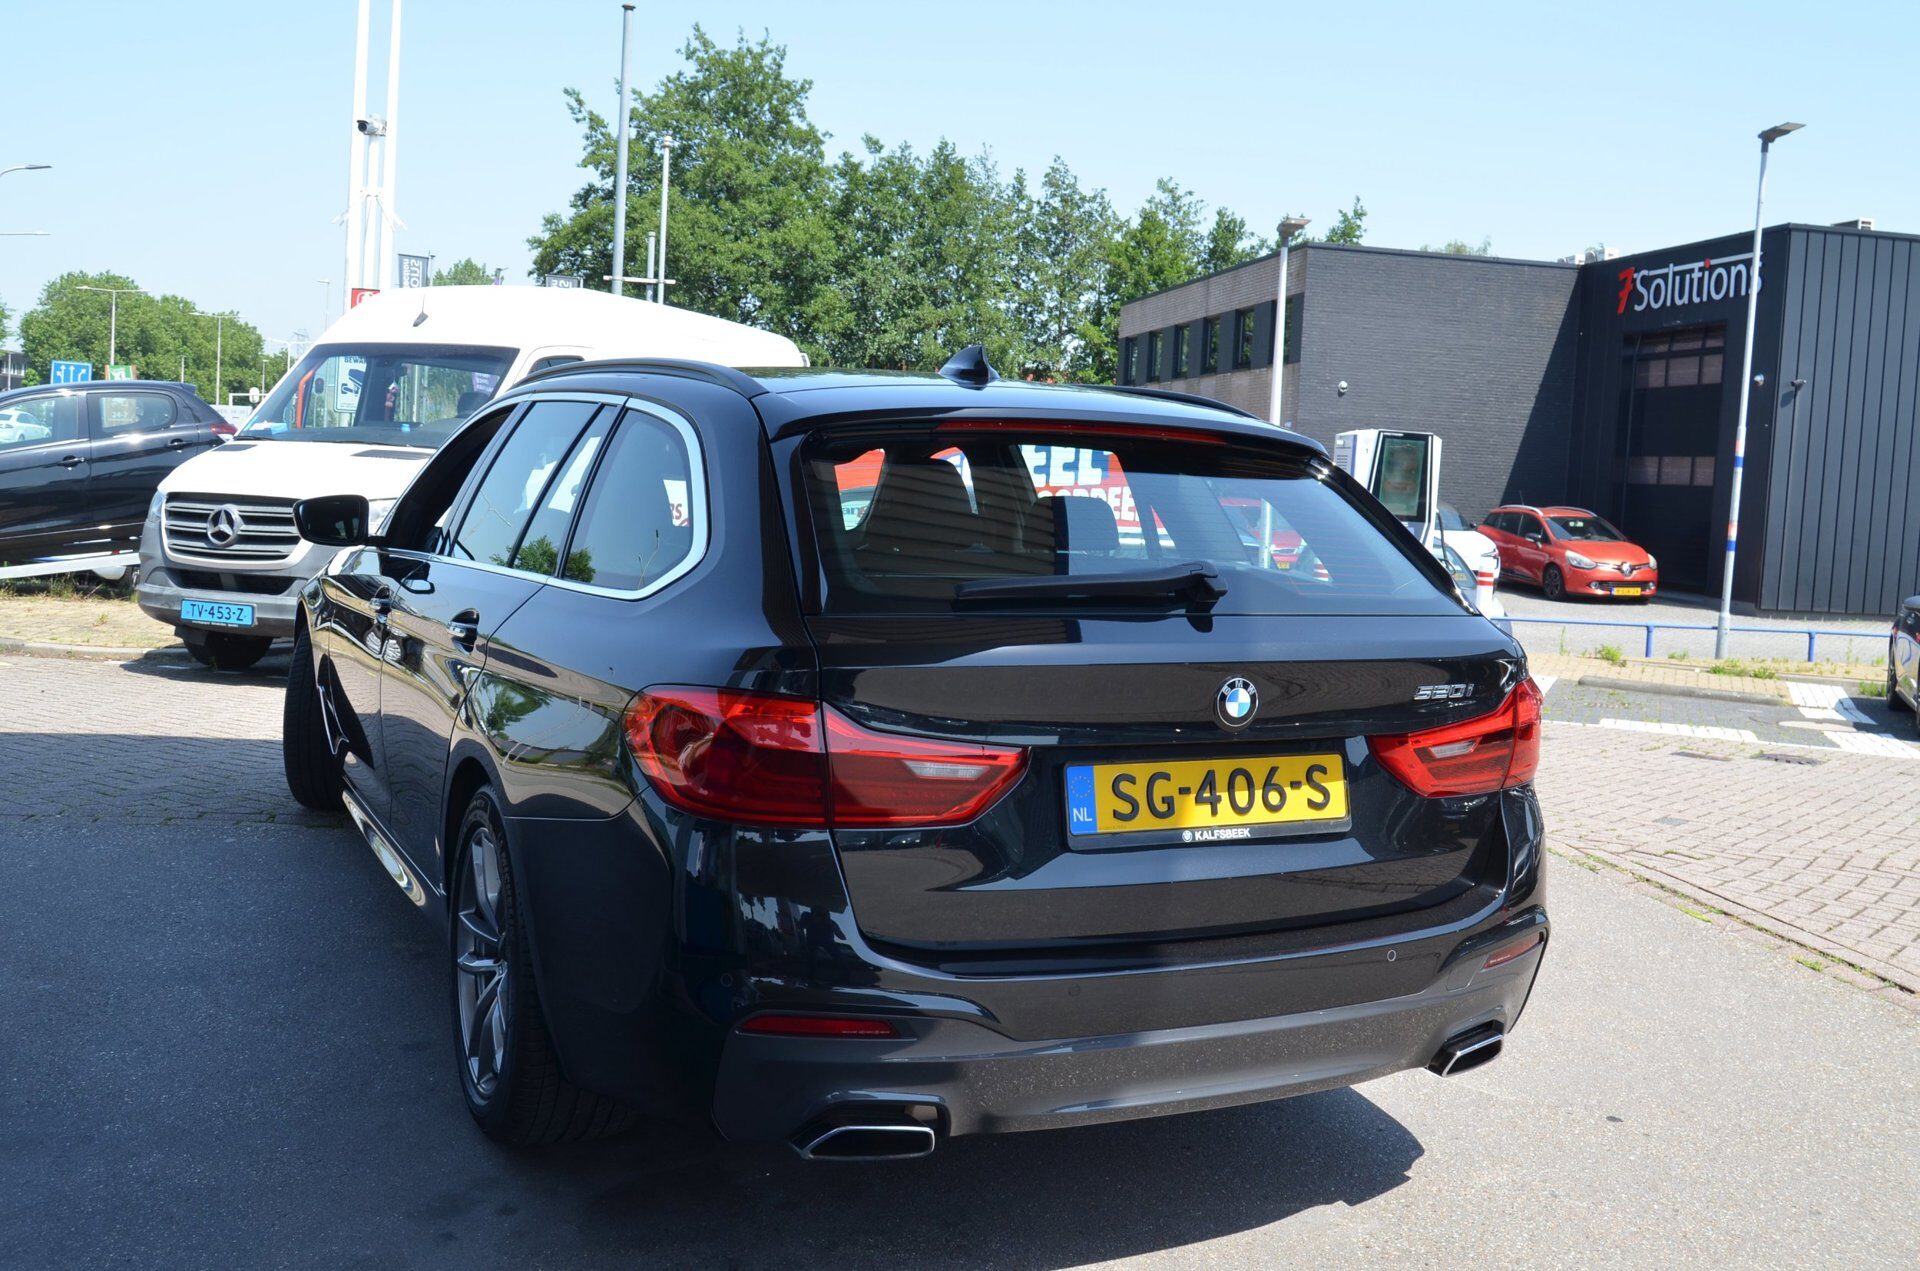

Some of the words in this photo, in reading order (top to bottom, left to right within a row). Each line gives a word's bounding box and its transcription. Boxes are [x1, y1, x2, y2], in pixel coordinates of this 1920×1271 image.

[190, 603, 244, 622] TV-453-Z
[1222, 679, 1256, 696] BMW
[1413, 683, 1475, 700] 520i
[1111, 764, 1331, 822] SG-406-S
[1073, 807, 1093, 823] NL
[1194, 827, 1251, 842] KALFSBEEK
